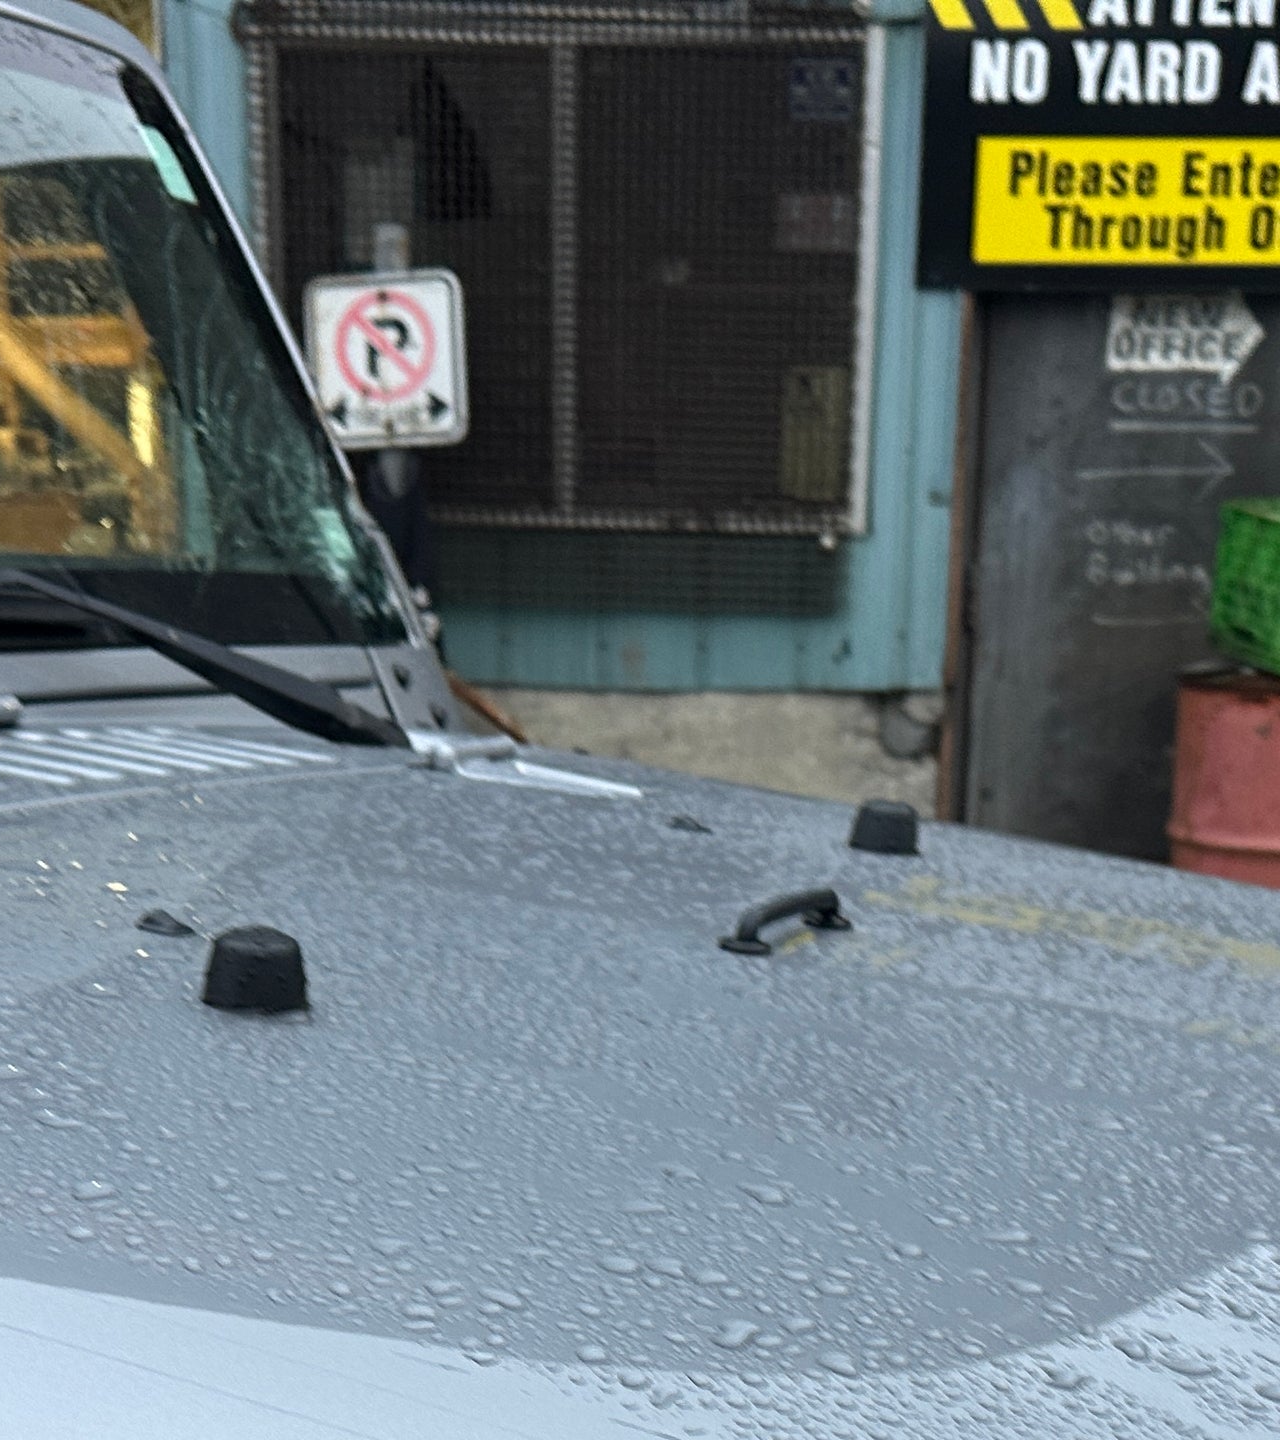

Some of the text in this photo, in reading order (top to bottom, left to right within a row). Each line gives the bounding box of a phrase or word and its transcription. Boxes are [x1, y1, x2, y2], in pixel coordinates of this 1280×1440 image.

[970, 37, 1049, 104] NO
[1071, 38, 1221, 104] YARD
[1008, 149, 1158, 198] Please
[1043, 203, 1227, 260] Through
[1114, 326, 1245, 361] OFFICE
[1111, 378, 1265, 418] CLOSED
